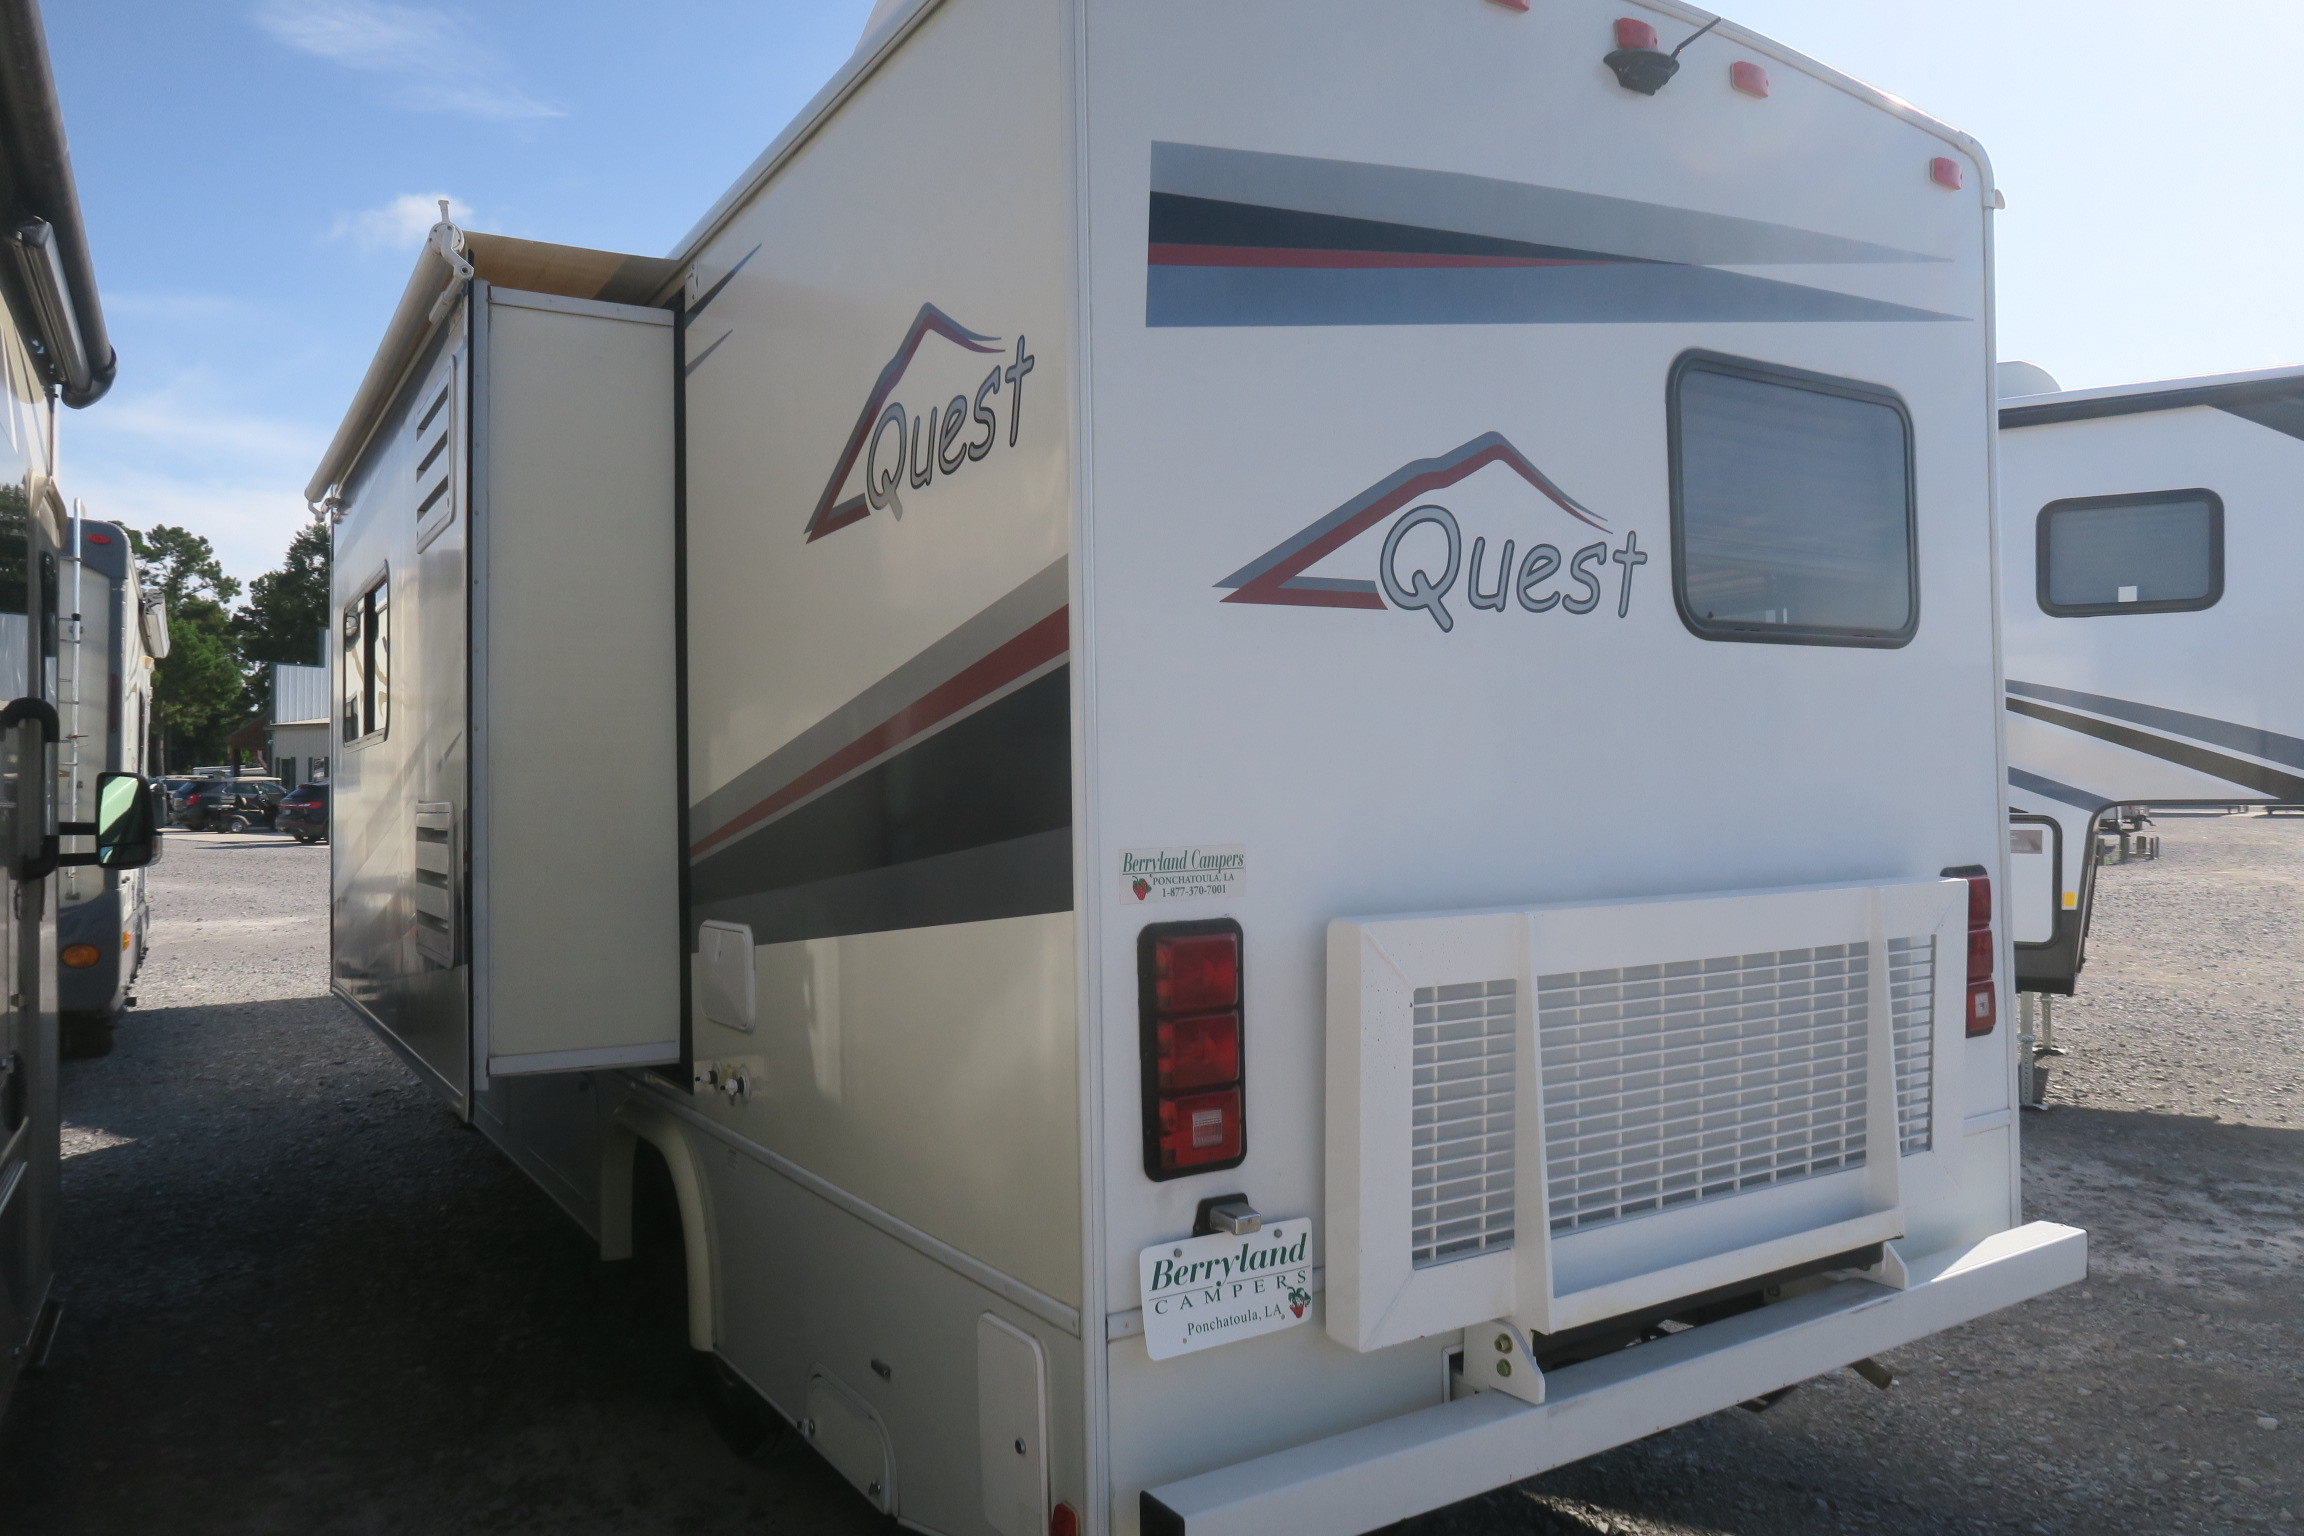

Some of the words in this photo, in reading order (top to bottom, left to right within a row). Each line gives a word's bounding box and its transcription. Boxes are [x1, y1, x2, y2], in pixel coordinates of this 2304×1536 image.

[866, 334, 1035, 522] Quest
[1379, 504, 1648, 633] Quest
[1122, 850, 1188, 877] Berryland
[1191, 849, 1244, 874] Campers
[1152, 875, 1222, 886] PONCHATOULA,
[1223, 873, 1234, 882] LA
[1162, 885, 1226, 897] 1-877-370-7001
[1151, 1232, 1308, 1291] Berryland
[1154, 1270, 1307, 1315] CAMPERS
[1187, 1309, 1262, 1336] Ponchatoula,
[1264, 1303, 1282, 1318] LA
